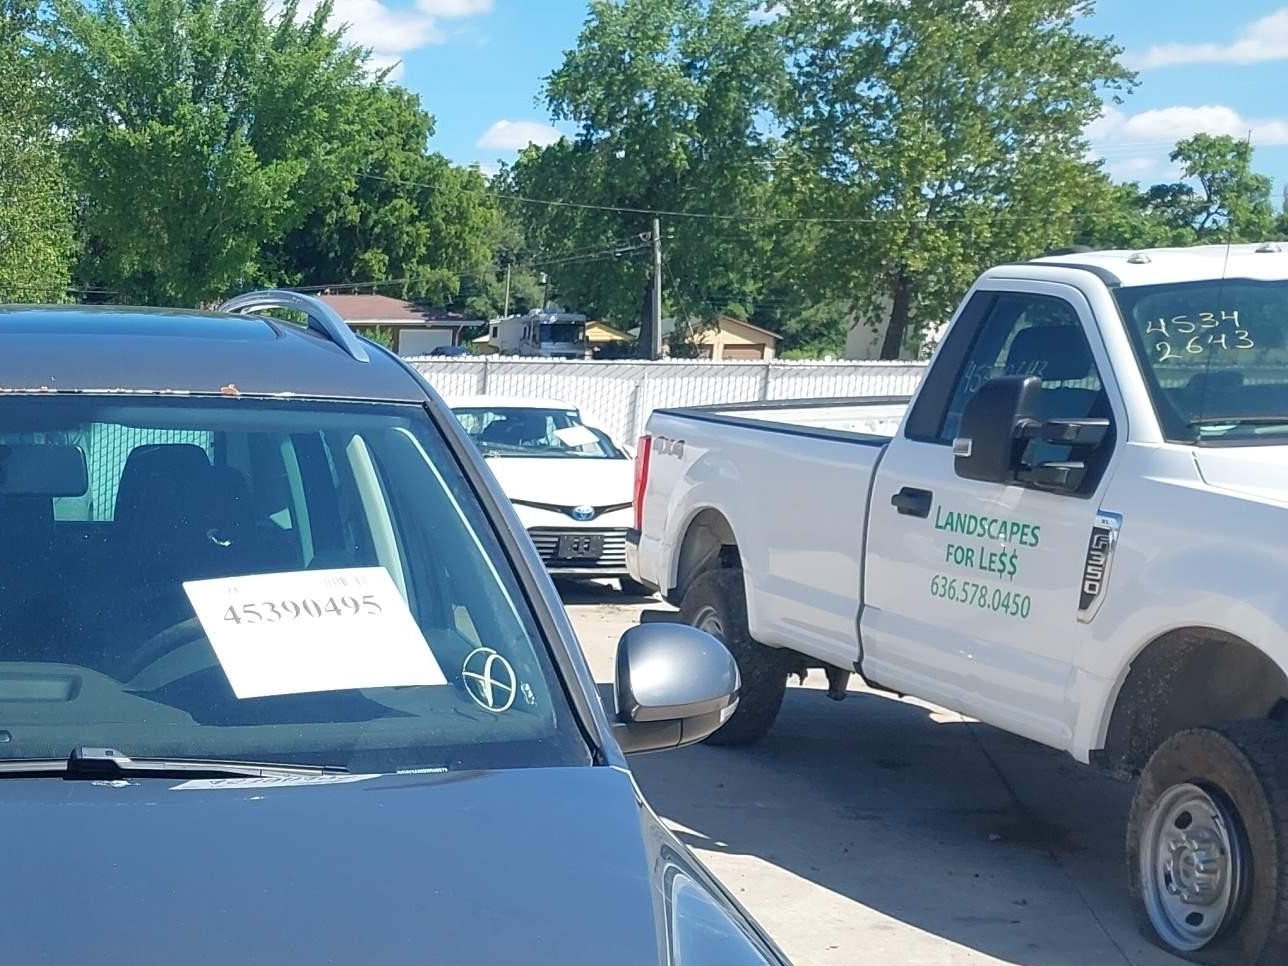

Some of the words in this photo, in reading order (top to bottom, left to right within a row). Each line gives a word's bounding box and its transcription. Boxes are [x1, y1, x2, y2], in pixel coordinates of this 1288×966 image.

[1145, 310, 1241, 338] 4534
[1155, 330, 1255, 362] 2643
[934, 505, 1041, 548] LANDSCAPES
[945, 543, 975, 568] FOR
[223, 594, 383, 625] 45390495
[930, 574, 1032, 620] 636.578.0450
